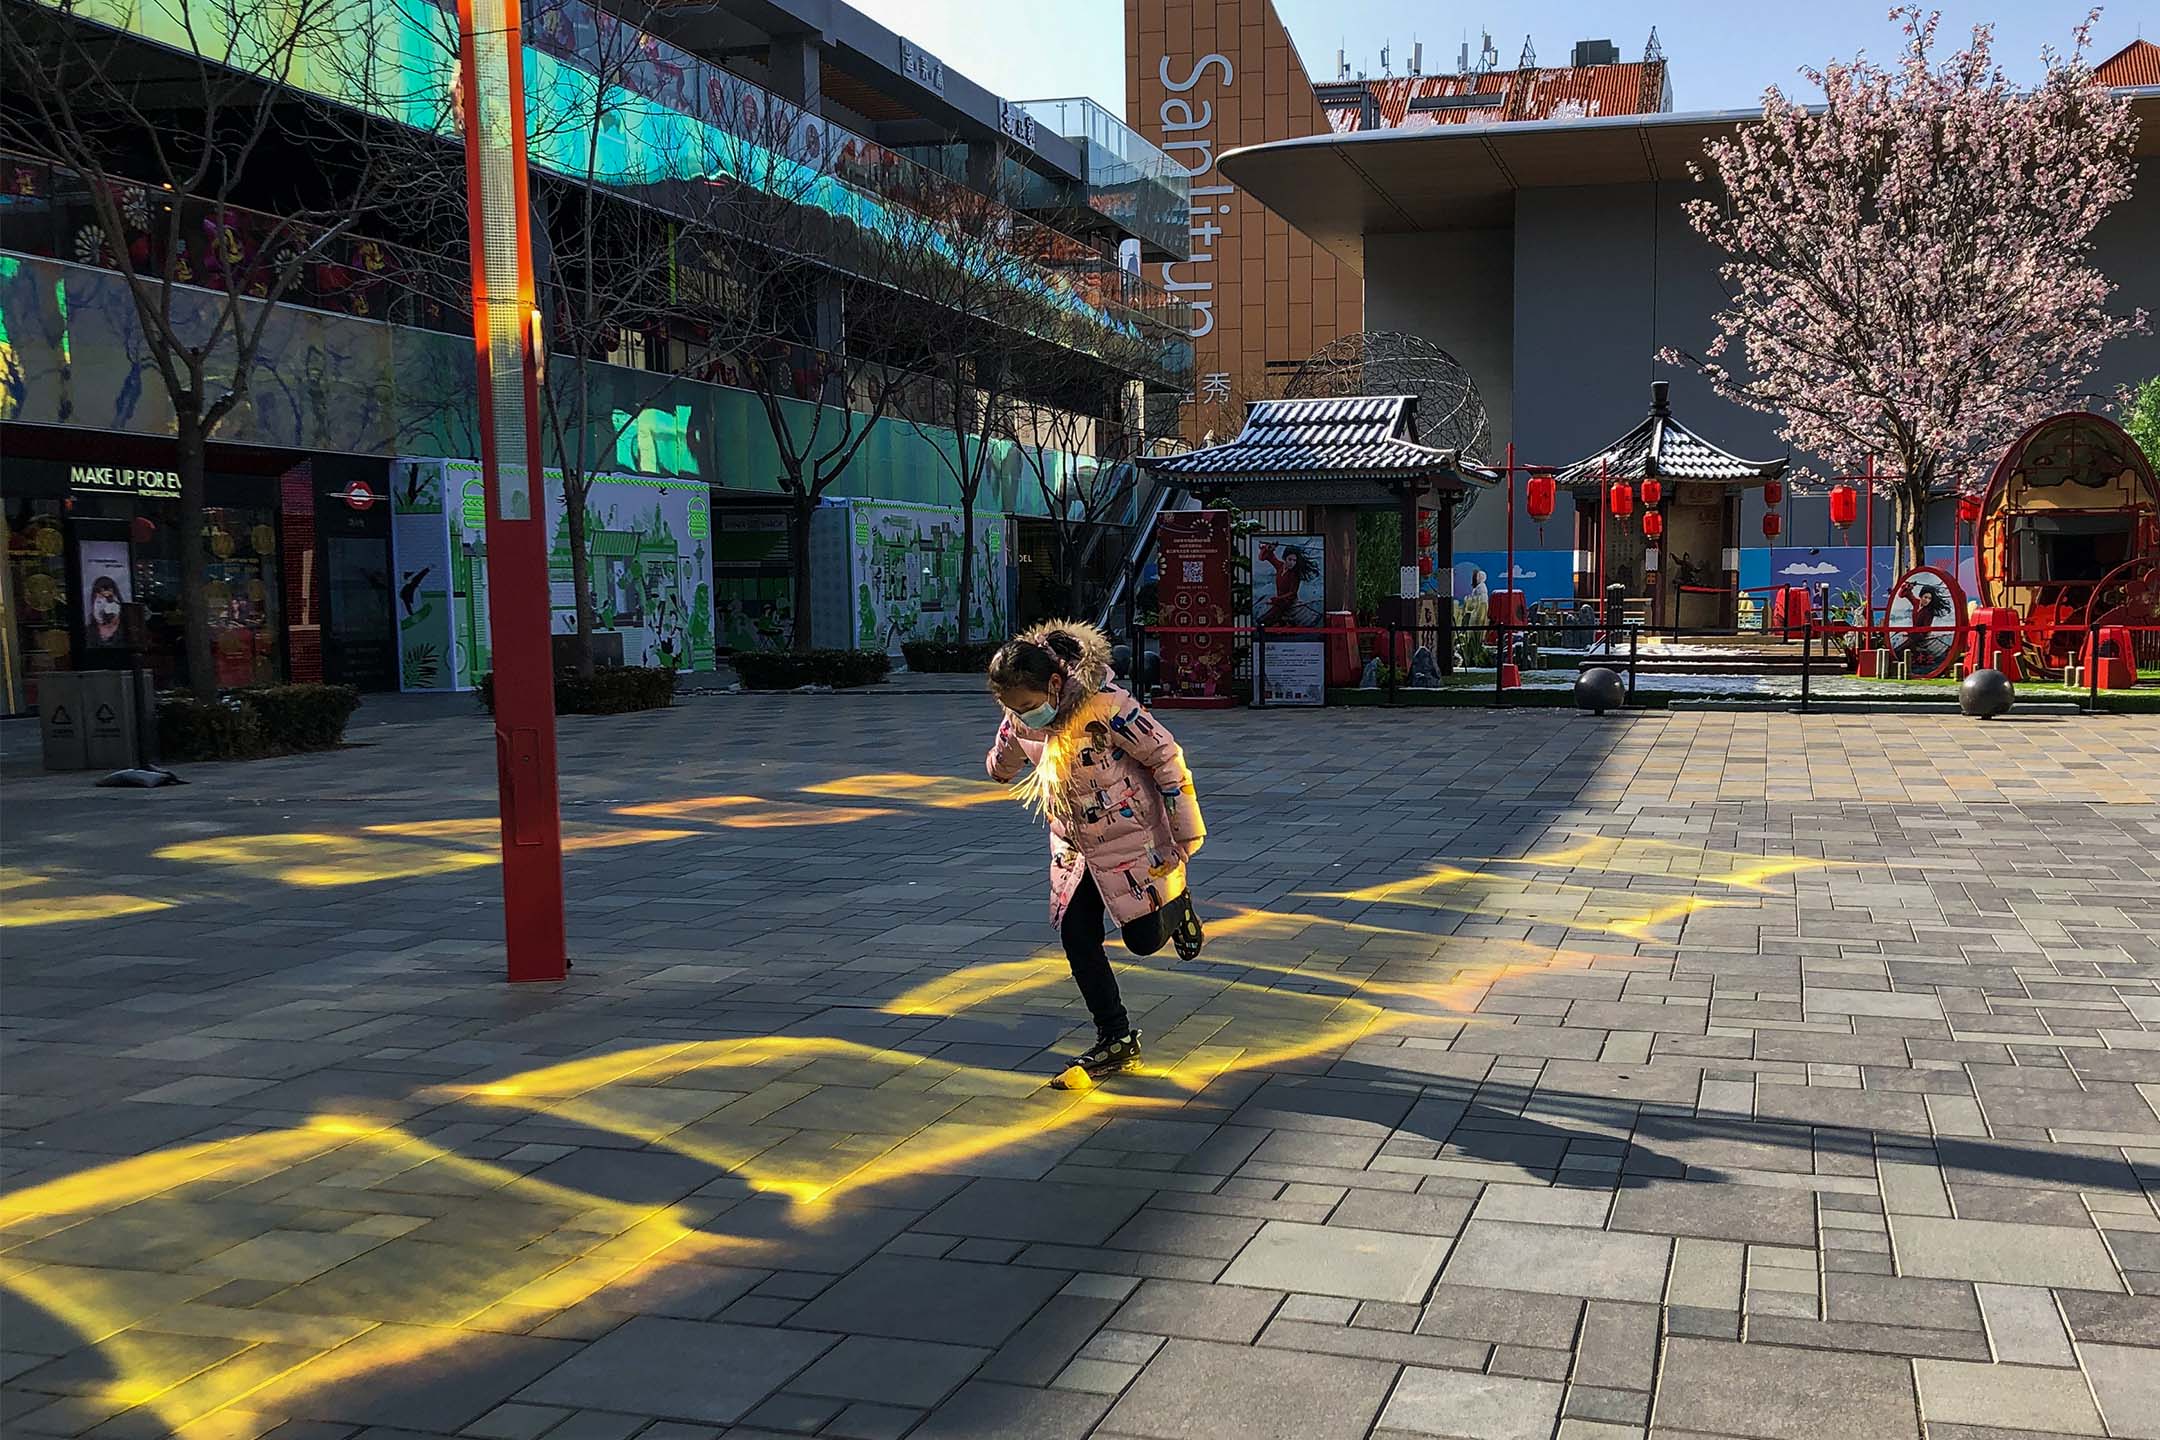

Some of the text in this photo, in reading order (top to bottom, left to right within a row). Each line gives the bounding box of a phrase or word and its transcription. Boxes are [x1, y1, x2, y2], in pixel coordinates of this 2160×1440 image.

[70, 466, 115, 485] MAKE
[116, 468, 136, 487] UP
[137, 470, 166, 488] FOR
